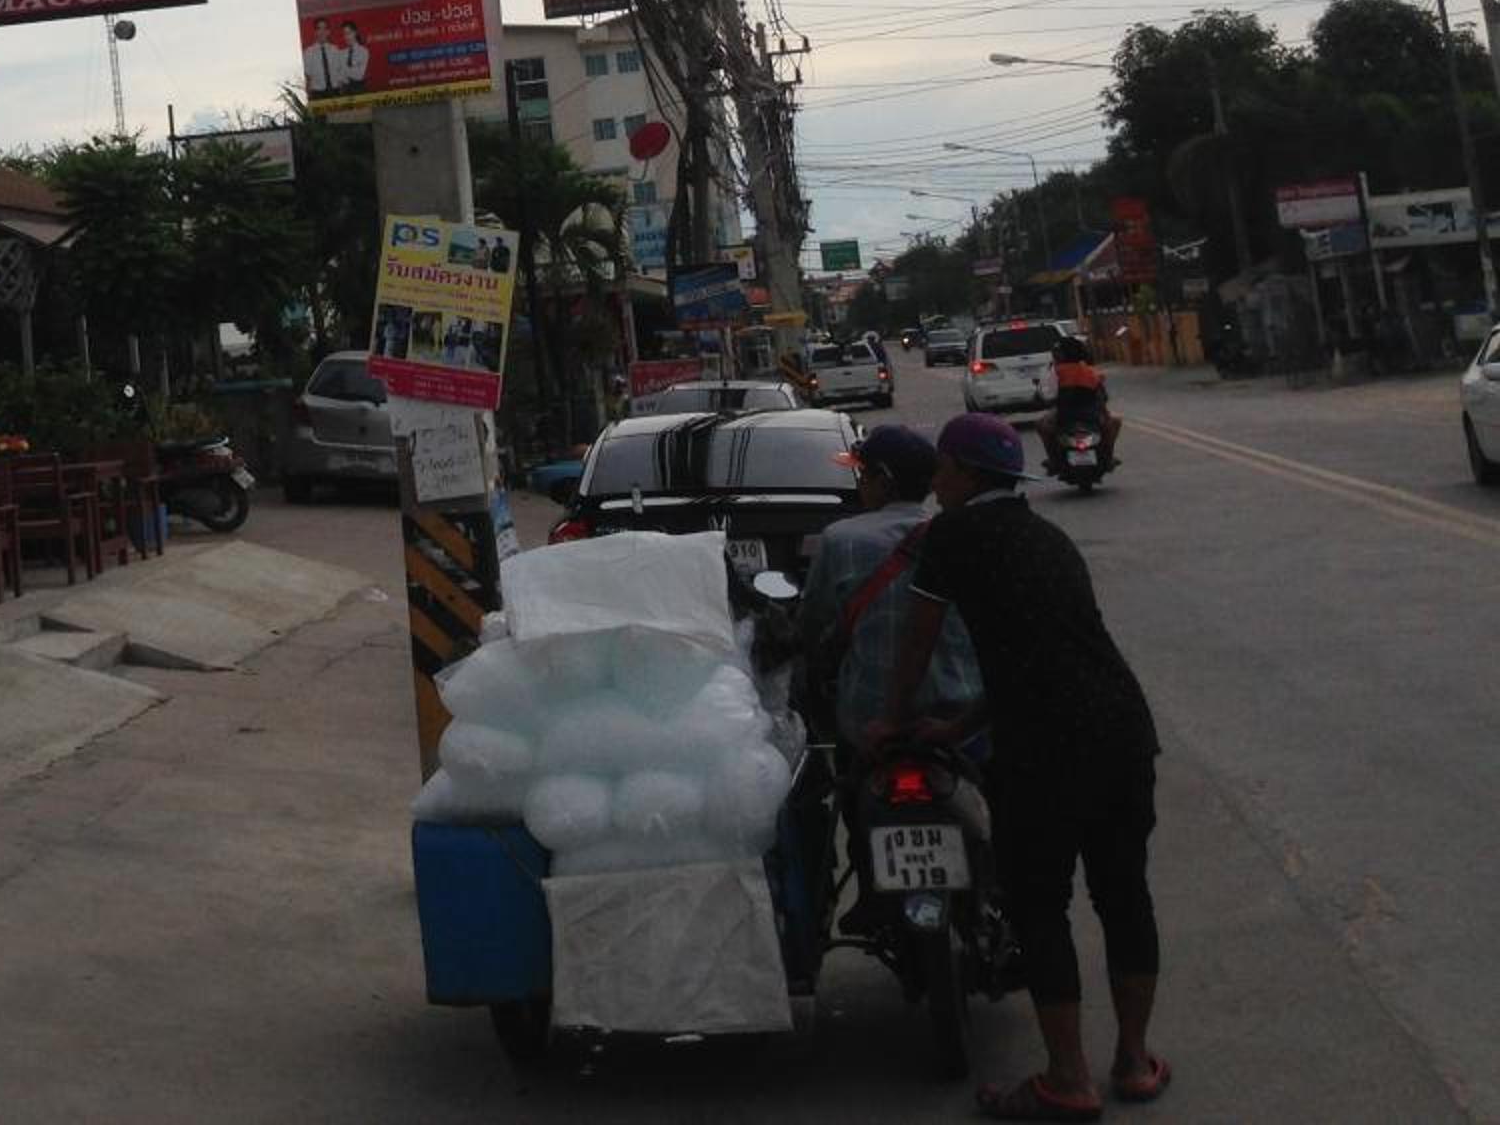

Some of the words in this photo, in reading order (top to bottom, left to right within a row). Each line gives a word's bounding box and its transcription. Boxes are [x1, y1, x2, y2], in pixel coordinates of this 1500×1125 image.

[386, 257, 499, 290] รับสมัครงาน
